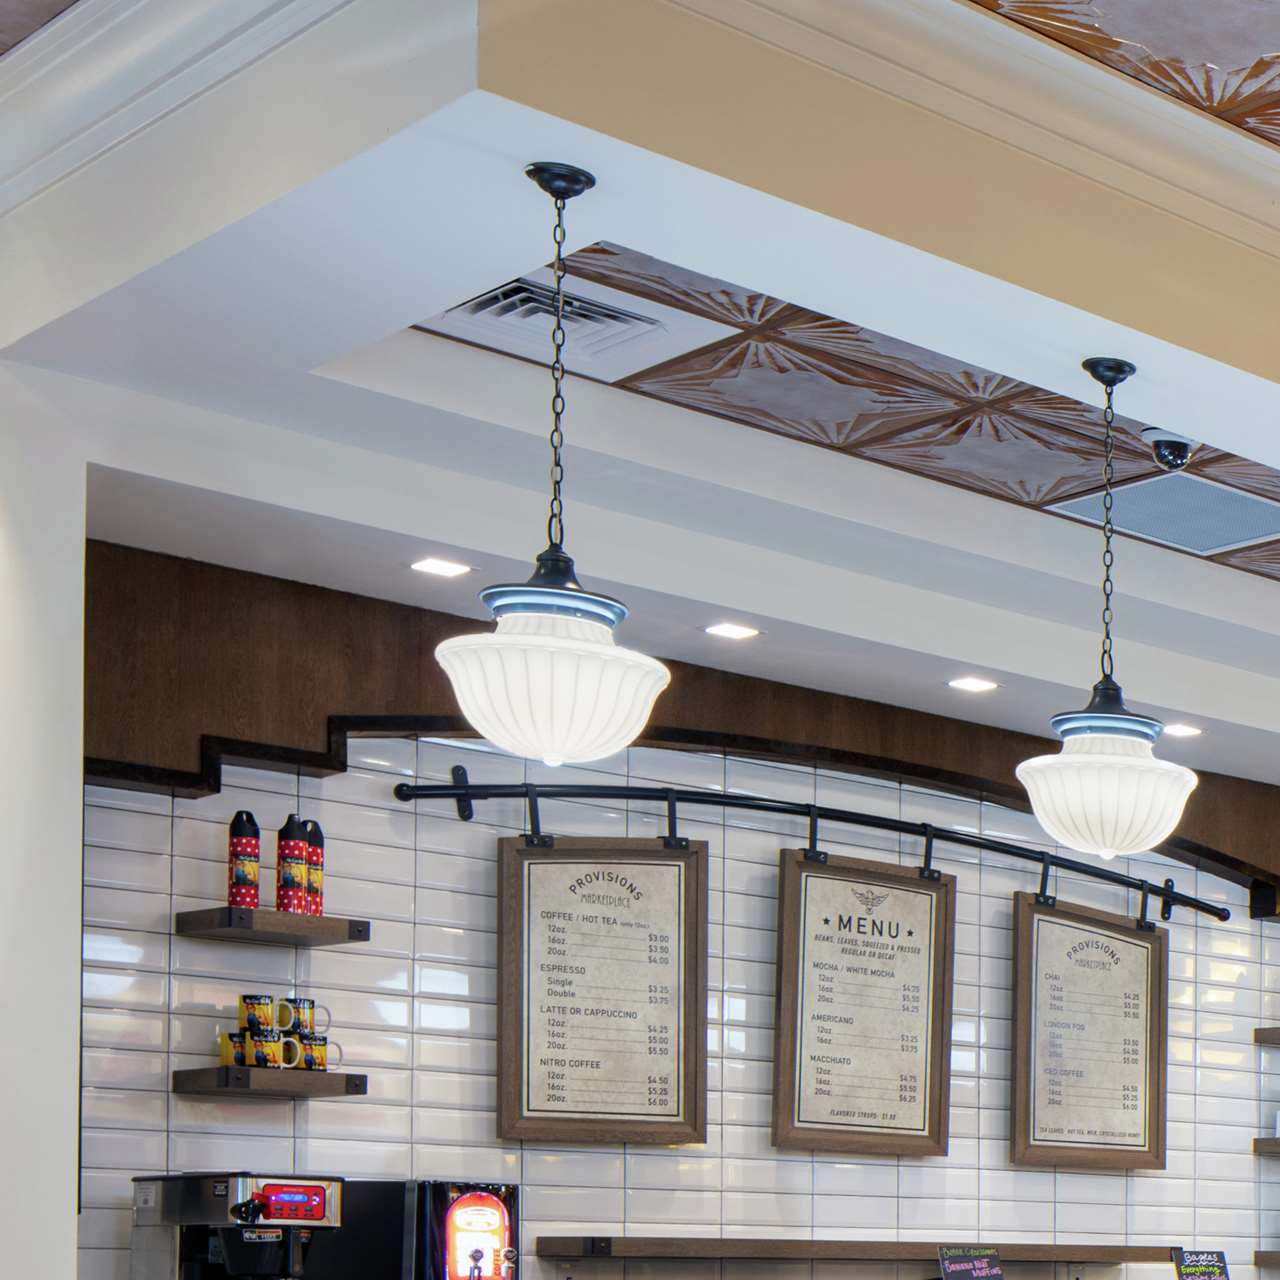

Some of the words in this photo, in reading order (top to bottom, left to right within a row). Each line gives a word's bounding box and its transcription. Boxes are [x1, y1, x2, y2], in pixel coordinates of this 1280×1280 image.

[569, 871, 644, 901] PROVISIONS
[540, 910, 573, 922] COFFEE
[582, 915, 599, 924] HOT
[602, 917, 618, 926] TEA
[547, 924, 568, 934] 12oz.
[648, 933, 669, 943] $3.00
[838, 914, 900, 939] MENU
[547, 935, 568, 945] 16oz.
[547, 947, 568, 957] 20oz.
[841, 947, 867, 957] REGULAR
[1066, 939, 1121, 965] PROVISIONS
[540, 963, 586, 975] ESPRESSO
[813, 961, 839, 972] MOCHA
[846, 966, 868, 976] WHITE
[870, 968, 896, 978] MOCHA
[547, 976, 574, 988] Single
[547, 988, 576, 998] Double
[540, 1005, 567, 1015] LATTE
[569, 1007, 582, 1016] OR
[584, 1008, 638, 1019] CAPPUCCINO
[811, 1013, 854, 1025] AMERICANO
[547, 1018, 568, 1028] 12oz.
[647, 1025, 669, 1034] $4.25
[547, 1029, 568, 1039] 16oz.
[648, 1036, 669, 1045] $5.00
[547, 1040, 568, 1050] 20oz.
[648, 1047, 669, 1056] $5.50
[539, 1058, 567, 1068] NITRO
[568, 1060, 601, 1069] COFFEE
[810, 1054, 852, 1065] MACCHIATO
[547, 1070, 568, 1080] 12oz.
[647, 1076, 669, 1085] $4.50
[547, 1082, 568, 1092] 16oz.
[647, 1087, 669, 1096] $5.25
[547, 1093, 568, 1103] 20oz.
[647, 1098, 669, 1106] $6.00
